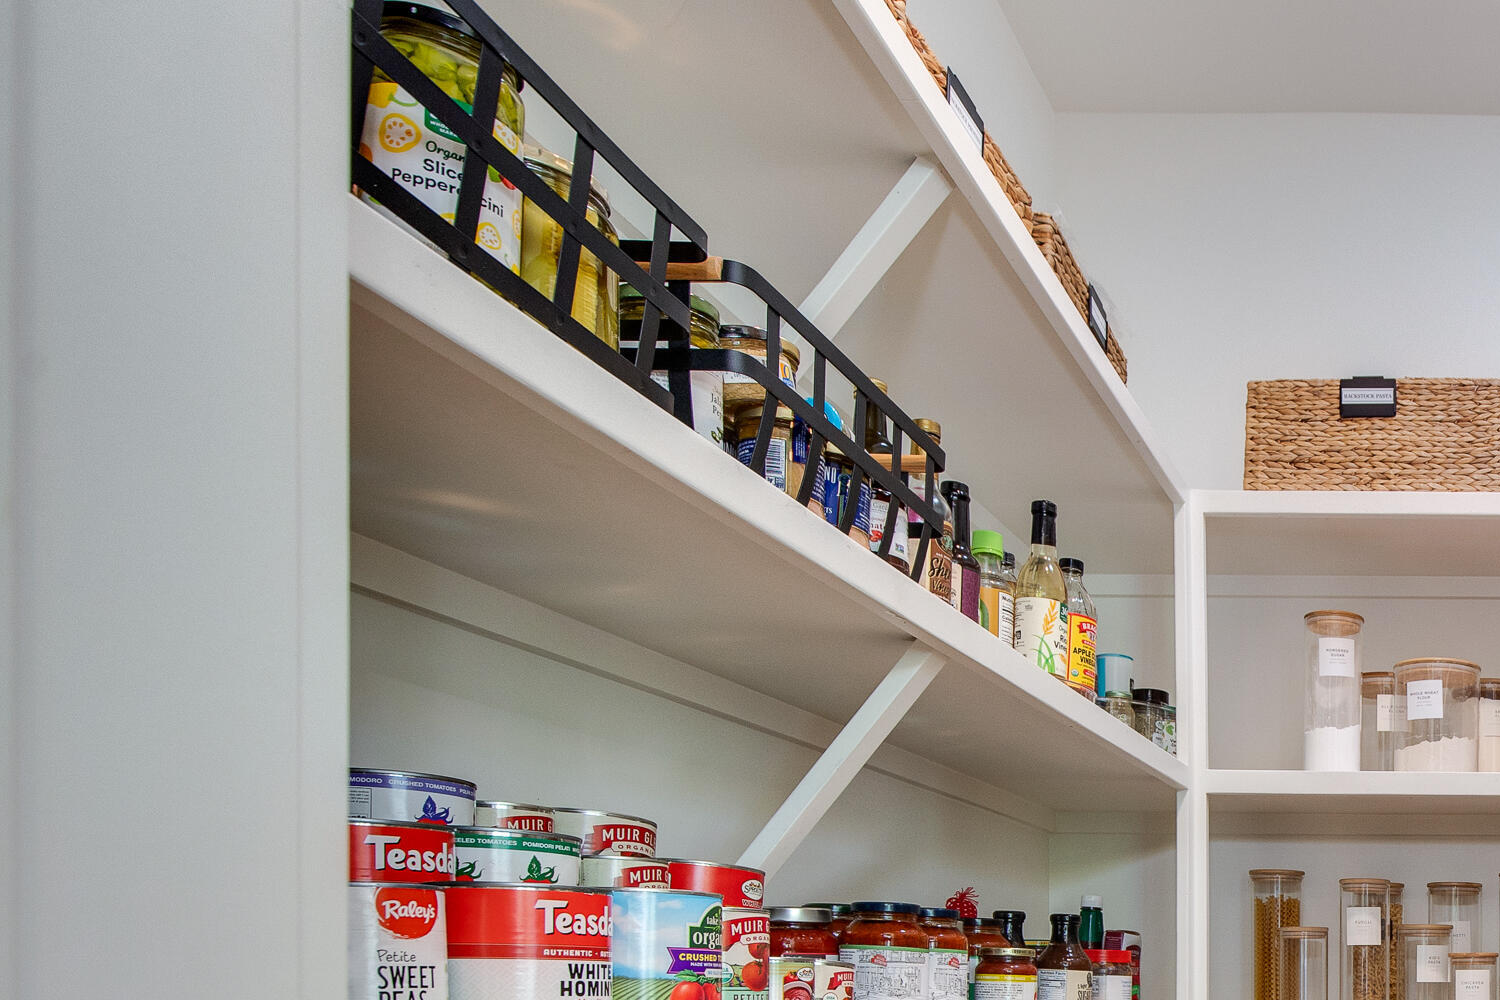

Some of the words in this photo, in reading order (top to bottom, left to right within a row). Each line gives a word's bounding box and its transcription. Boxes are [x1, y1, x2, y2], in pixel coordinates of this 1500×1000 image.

[391, 168, 505, 218] Peppercini
[476, 838, 518, 846] TOMATOES
[602, 828, 640, 842] MUIR
[629, 869, 663, 883] MUIR
[381, 900, 436, 924] Raley's
[730, 920, 763, 936] MUIR
[377, 949, 417, 963] Petite
[543, 949, 593, 957] AUTHENTIC
[678, 951, 718, 962] CRUSHED
[377, 965, 436, 990] SWEET
[568, 963, 612, 980] WHITE
